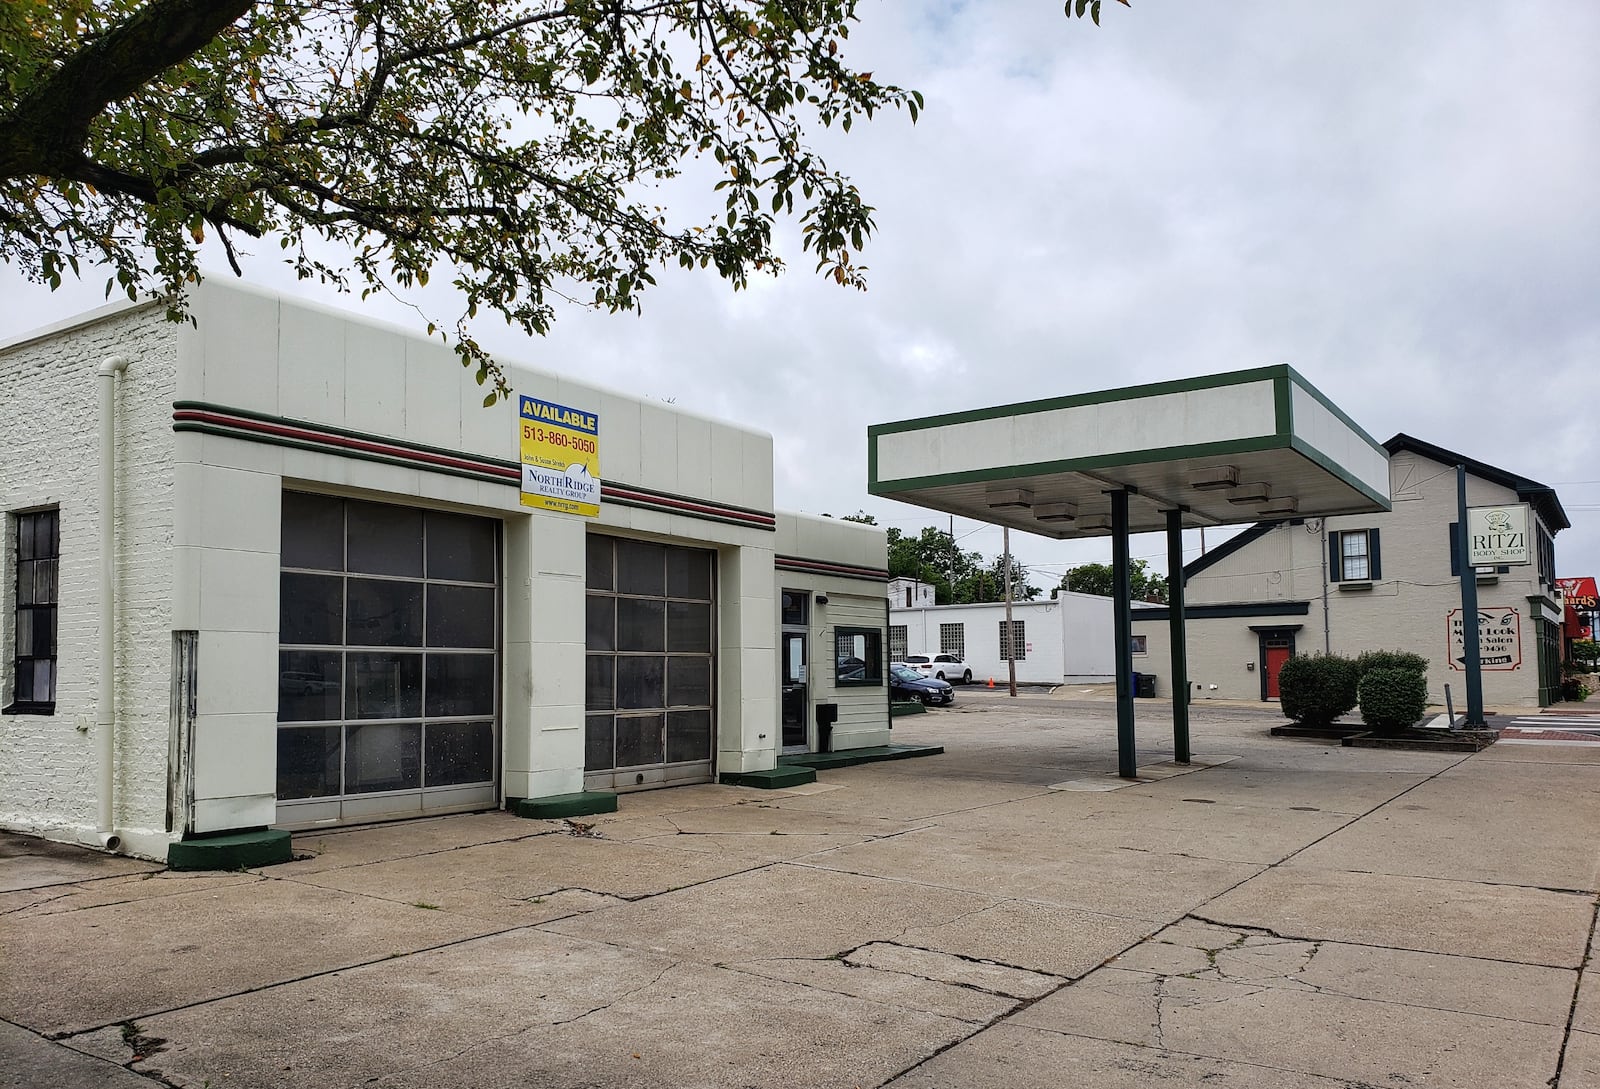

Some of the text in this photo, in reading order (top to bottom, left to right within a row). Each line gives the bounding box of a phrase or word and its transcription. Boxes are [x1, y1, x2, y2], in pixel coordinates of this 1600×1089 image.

[523, 400, 595, 431] AVAILABLE
[524, 426, 595, 454] 513-860-5050
[540, 485, 587, 500] REALTY GROUP
[1473, 532, 1524, 550] RITZI
[1473, 549, 1497, 557] BODY
[1486, 627, 1516, 635] Look
